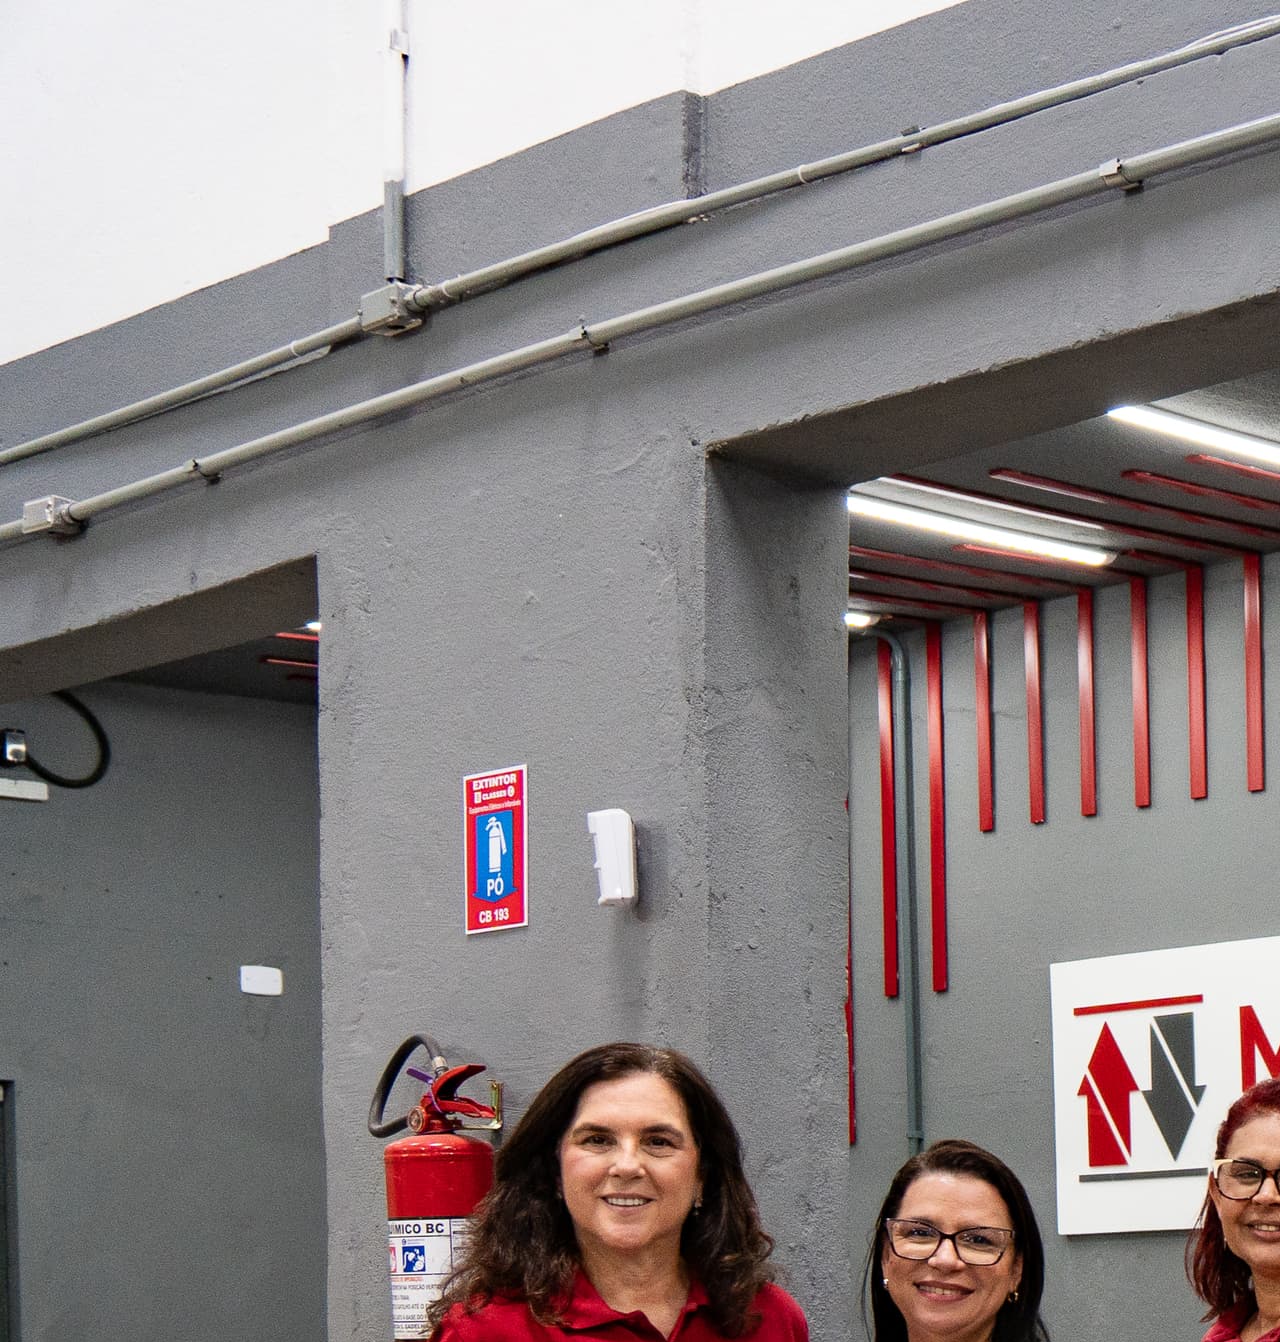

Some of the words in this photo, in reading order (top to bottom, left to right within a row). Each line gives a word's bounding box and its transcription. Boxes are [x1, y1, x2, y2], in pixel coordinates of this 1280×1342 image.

[472, 773, 517, 791] EXTINTOR
[487, 872, 504, 897] PÓ
[479, 911, 492, 924] CB
[494, 908, 509, 921] 193
[426, 1223, 444, 1234] BC
